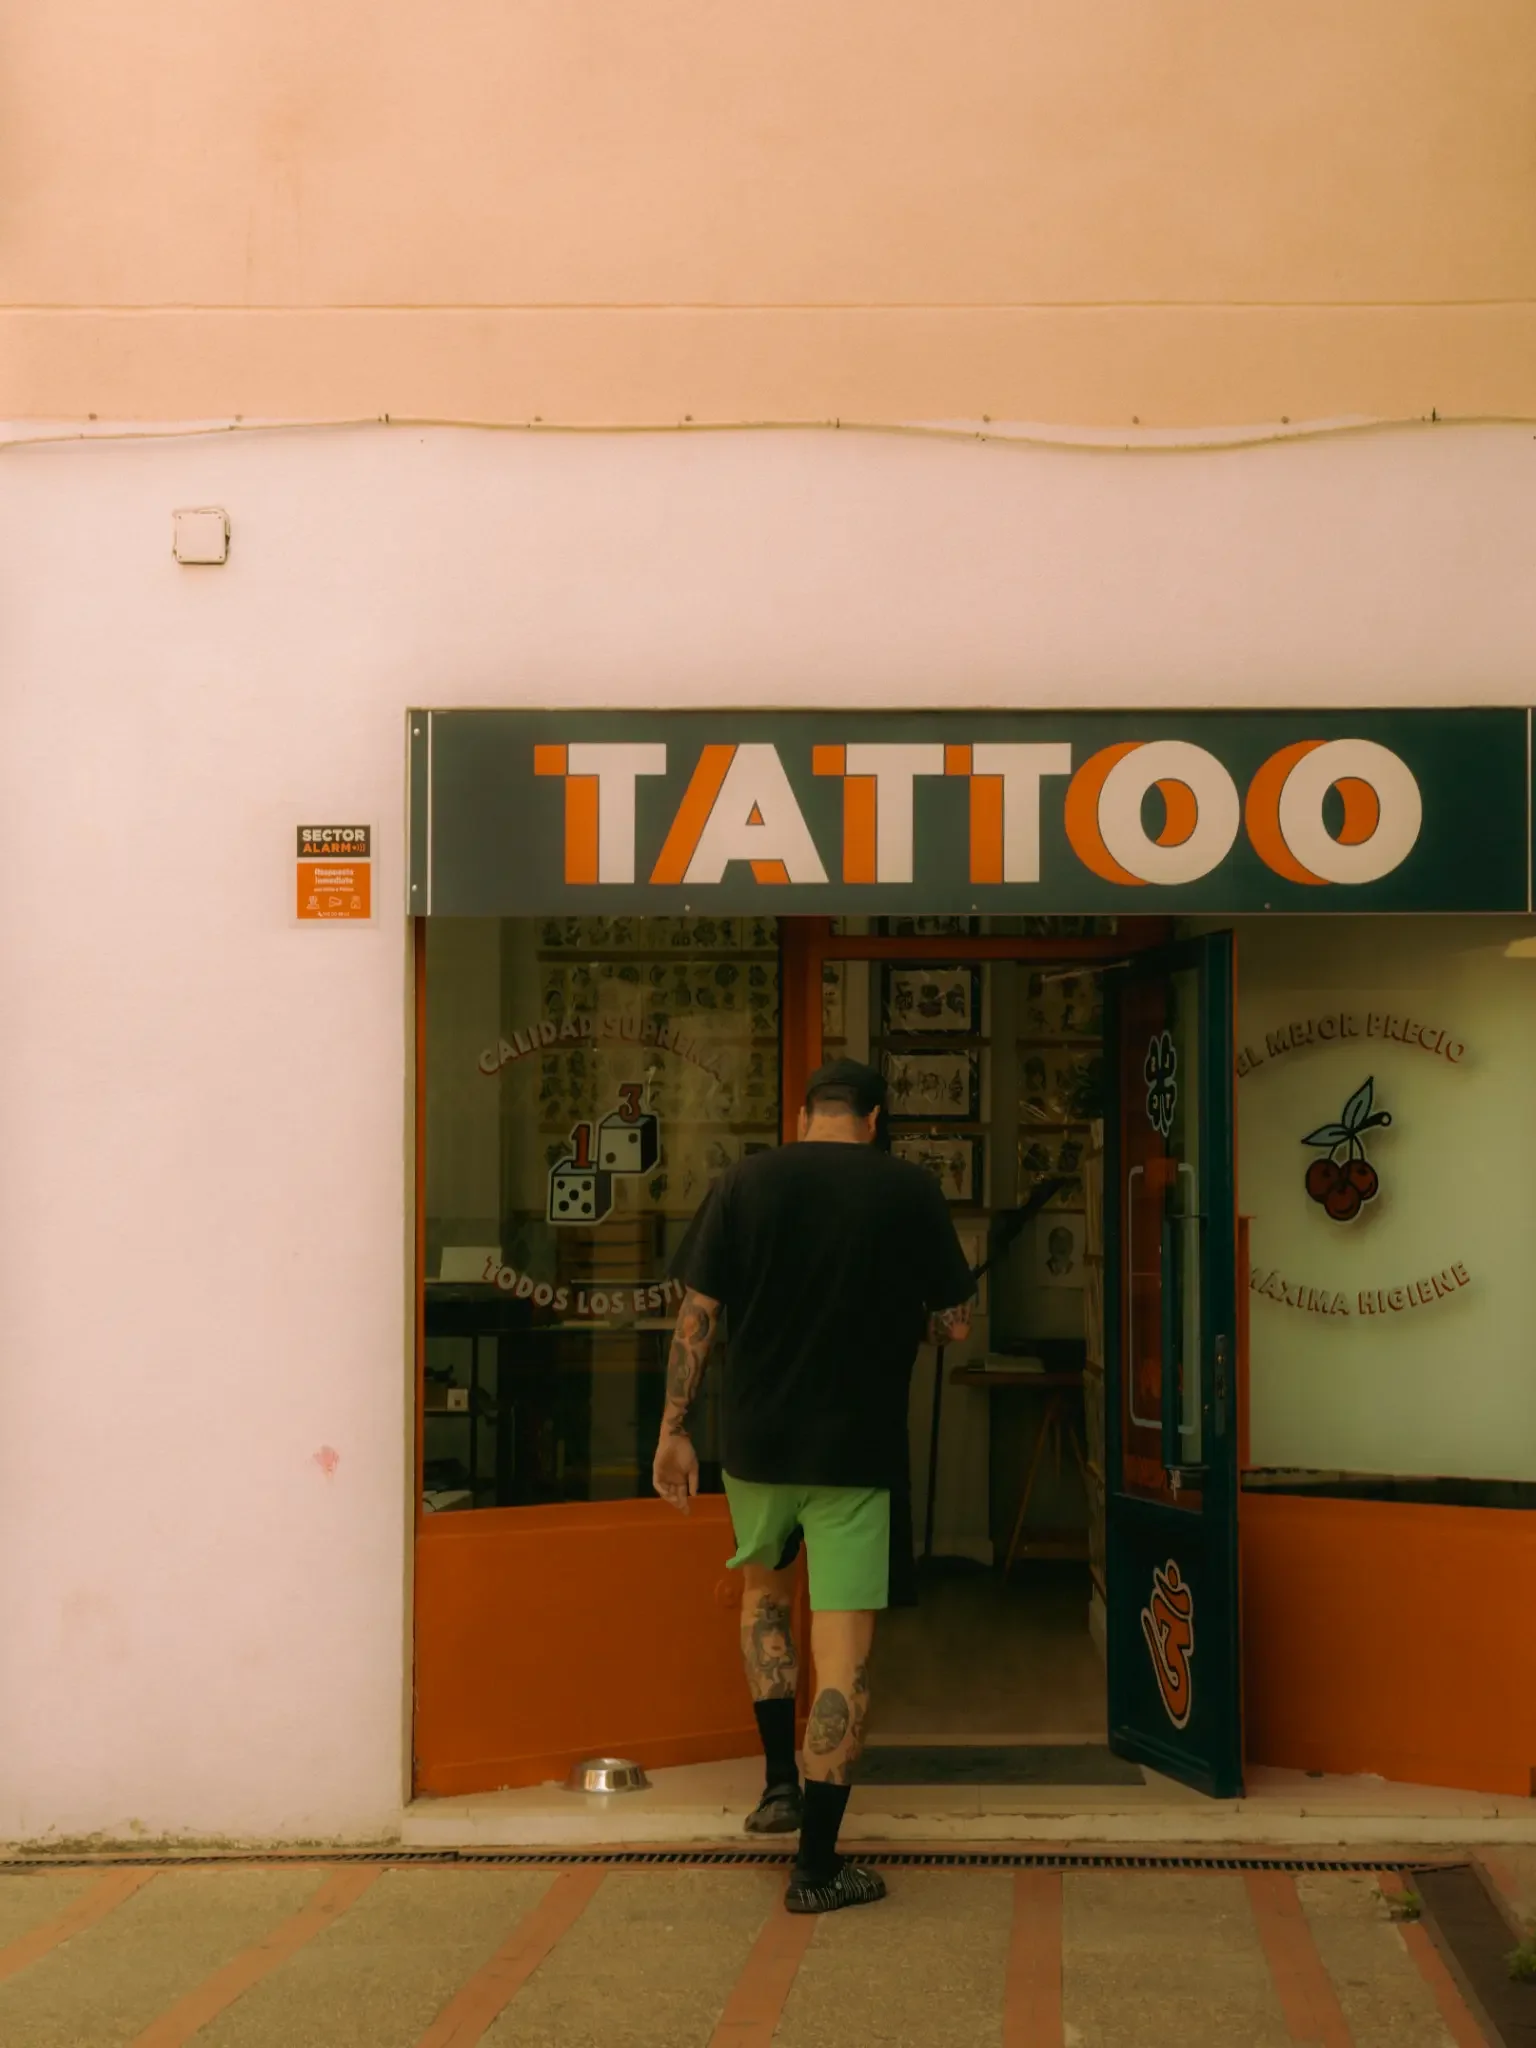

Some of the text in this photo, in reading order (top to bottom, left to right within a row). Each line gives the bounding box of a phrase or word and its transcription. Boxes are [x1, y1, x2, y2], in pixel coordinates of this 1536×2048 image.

[302, 828, 365, 841] SECTOR
[533, 737, 1423, 886] TATTOO
[303, 843, 351, 852] ALARM
[478, 1016, 592, 1075] CALIDAD
[1265, 1013, 1361, 1058] MEJOR
[1366, 1012, 1467, 1064] PRECIO
[571, 1083, 644, 1169] 1 3
[481, 1255, 685, 1316] TODOS LOS ESTI
[1357, 1260, 1471, 1316] HIGIENE
